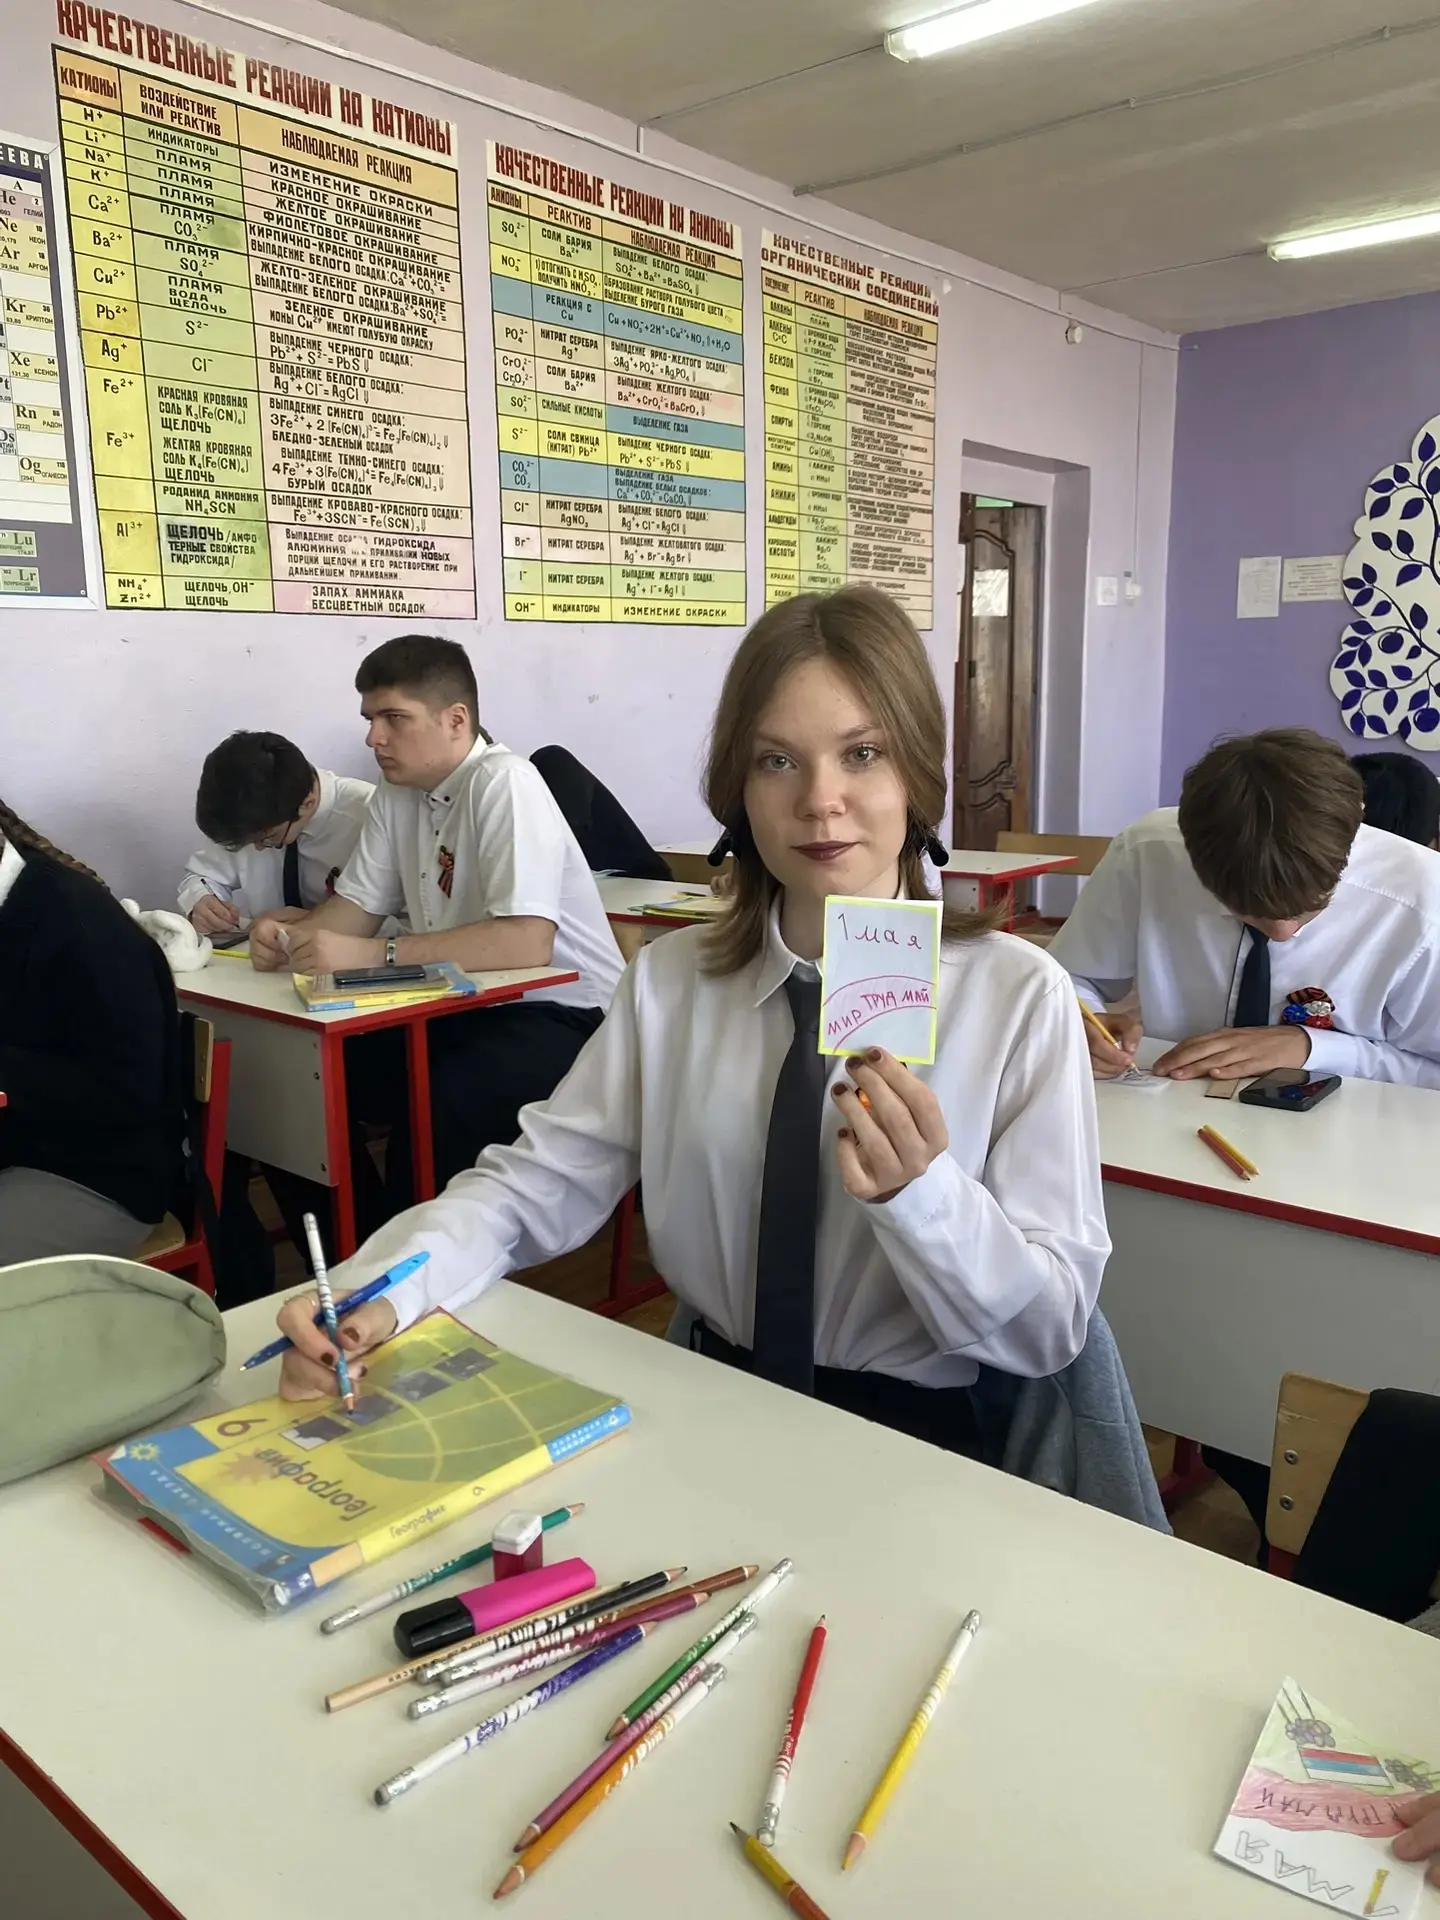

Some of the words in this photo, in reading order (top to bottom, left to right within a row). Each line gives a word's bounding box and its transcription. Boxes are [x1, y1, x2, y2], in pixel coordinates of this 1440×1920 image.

[57, 0, 236, 88] КАЧЕСТВЕННЫЕ
[246, 59, 332, 118] РЕАКЦИИ
[340, 87, 363, 128] НА
[372, 98, 451, 156] КАТИОНЫ
[60, 66, 117, 99] КАТИОНЫ
[140, 84, 217, 120] ВОЗДЕЙСТВИЕ
[141, 101, 163, 119] ИЛИ
[171, 110, 220, 136] РЕАКТИВ
[148, 128, 218, 156] ИНДИКАТОРЫ
[156, 149, 211, 172] ПЛАМЯ
[282, 128, 359, 169] НАБЛЮДАЕМАЯ
[367, 154, 412, 184] РЕАКЦИЯ
[158, 167, 213, 190] ПЛАМЯ
[160, 186, 214, 208] ПЛАМЯ
[270, 161, 360, 197] ИЗМЕНЕНИЕ
[370, 190, 432, 217] ОКРАСКИ
[491, 189, 522, 209] АНИОНЫ
[495, 142, 604, 208] КАЧЕСТВЕННЫЕ
[610, 183, 664, 228] РЕАКЦИИ
[669, 203, 684, 234] НА
[690, 210, 734, 250] АНИОНЫ
[160, 204, 215, 224] ПЛАМЯ
[271, 179, 328, 204] КРАСНОЕ
[337, 197, 421, 229] ОКРАШИВАНИЕ
[276, 197, 326, 221] ЖЕЛТОЕ
[335, 214, 420, 245] ОКРАШИВАНИЕ
[547, 205, 592, 230] РЕАКТИВ
[264, 211, 348, 242] ФИОЛЕТОВОЕ
[355, 235, 438, 265] ОКРАШИВАНИЕ
[542, 228, 561, 243] СОЛИ
[566, 235, 592, 251] БАРИЯ
[1, 245, 20, 260] Ar
[165, 240, 219, 260] ПЛАМЯ
[250, 224, 364, 261] КИРПИЧНО-КРАСНОЕ
[369, 255, 450, 283] ОКРАШИВАНИЕ
[251, 239, 305, 261] ВЫПАДЕНИЕ
[309, 251, 350, 272] БЕЛОГО
[686, 250, 716, 269] РЕАКЦИЯ
[652, 257, 680, 274] БЕЛОГО
[773, 234, 874, 279] КАЧЕСТВЕННЫЕ
[881, 271, 931, 299] РЕАКЦИИ
[169, 276, 223, 294] ПЛАМЯ
[255, 274, 309, 296] ВЫПАДЕНИЕ
[313, 287, 354, 305] БЕЛОГО
[261, 261, 356, 292] ЖЕЛТО-ЗЕЛЕНОЕ
[364, 285, 446, 311] ОКРАШИВАНИЕ
[761, 248, 860, 292] ОРГАНИЧЕСКИХ
[866, 283, 939, 317] СОЕДИНЕНИЙ
[170, 288, 208, 302] ВОДА
[546, 294, 583, 311] РЕАКЦИЯ
[804, 290, 835, 310] РЕАКТИВ
[6, 298, 26, 313] Kr
[170, 297, 227, 314] ЩЕЛОЧЬ
[26, 314, 53, 324] КРИПТОН
[285, 300, 334, 319] ЗЕЛЕНОЕ
[344, 314, 428, 338] ОКРАШИВАНИЕ
[358, 327, 397, 344] ГОЛУБУЮ
[401, 336, 433, 351] ОКРАСКУ
[540, 328, 567, 343] НИТРАТ
[569, 336, 598, 350] СЕРЕБРА
[10, 352, 30, 366] Xe
[270, 332, 322, 351] ВЫПАДЕНИЕ
[328, 342, 373, 360] ЧЕРНОГО
[380, 349, 413, 367] ОСАДКА:
[769, 353, 794, 368] БЕНЗОЛ
[34, 368, 58, 377] КСЕНОН
[270, 362, 322, 381] ВЫПАДЕНИЕ
[327, 370, 365, 388] БЕЛОГО
[371, 379, 403, 395] ОСАДКА:
[547, 365, 567, 378] СОЛИ
[571, 370, 596, 382] БАРИЯ
[158, 386, 198, 402] КРАСНАЯ
[204, 392, 248, 408] КРОВЯНАЯ
[16, 404, 37, 419] Rn
[159, 402, 182, 415] СОЛЬ
[270, 398, 322, 416] ВЫПАДЕНИЕ
[327, 405, 364, 421] СИНЕГО
[372, 412, 405, 427] ОСАДКА:
[542, 399, 571, 414] СИЛЬНЫЕ
[575, 405, 603, 419] КИСЛОТЫ
[42, 420, 62, 428] РАДОН
[161, 417, 211, 434] ЩЕЛОЧЬ
[163, 436, 200, 452] ЖЕЛТАЯ
[206, 442, 252, 458] КРОВЯНАЯ
[273, 430, 362, 450] БЛЕДНО-ЗЕЛЕНЫЙ
[366, 440, 393, 454] ОСАДОК
[547, 429, 567, 442] СОЛИ
[571, 433, 600, 446] СВИНЦА
[20, 457, 42, 474] Og
[163, 452, 186, 465] СОЛЬ
[282, 447, 332, 463] ВЫПАДЕНИЕ
[339, 453, 406, 472] ТЕМНО-СИНЕГО
[165, 467, 215, 483] ЩЕЛОЧЬ
[163, 485, 209, 500] РОДАНИД
[215, 490, 259, 503] АММОНИЯ
[288, 477, 325, 491] БУРЫЙ
[332, 483, 372, 496] ОСАДОК
[272, 494, 323, 510] ВЫПАДЕНИЕ
[328, 499, 428, 519] КРОВАВО-КРАСНОГО
[546, 499, 571, 512] НИТРАТ
[575, 502, 603, 514] СЕРЕБРА
[14, 532, 33, 545] Lu
[167, 524, 223, 541] ЩЕЛОЧЬ
[168, 540, 206, 553] ТЕРНЫЕ
[210, 542, 255, 555] СВОЙСТВА
[287, 542, 346, 555] АЛЮМИНИЯ
[421, 550, 450, 562] НОВЫХ
[374, 536, 435, 551] ГИДРОКСИДА
[548, 538, 574, 549] НИТРАТ
[576, 540, 604, 551] СЕРЕБРА
[19, 569, 36, 581] Lr
[548, 574, 574, 585] НИТРАТ
[576, 575, 604, 586] СЕРЕБРА
[186, 595, 228, 607] ЩЕЛОЧЬ
[313, 585, 348, 597] ЗАПАХ
[356, 588, 404, 600] АММИАКА
[313, 599, 383, 612] БЕСЦВЕТНЫЙ
[389, 601, 425, 614] ОСАДОК
[553, 603, 600, 614] ИНДИКАТОРЫ
[624, 607, 680, 617] ИЗМЕНЕНИЕ
[686, 609, 727, 617] ОКРАСКИ
[838, 913, 848, 940] 1
[855, 926, 922, 949] мая
[828, 1009, 862, 1036] МИР
[861, 990, 898, 1011] ТРУД
[902, 988, 929, 1002] МАЙ
[255, 1448, 377, 1521] География
[391, 1504, 447, 1538] География
